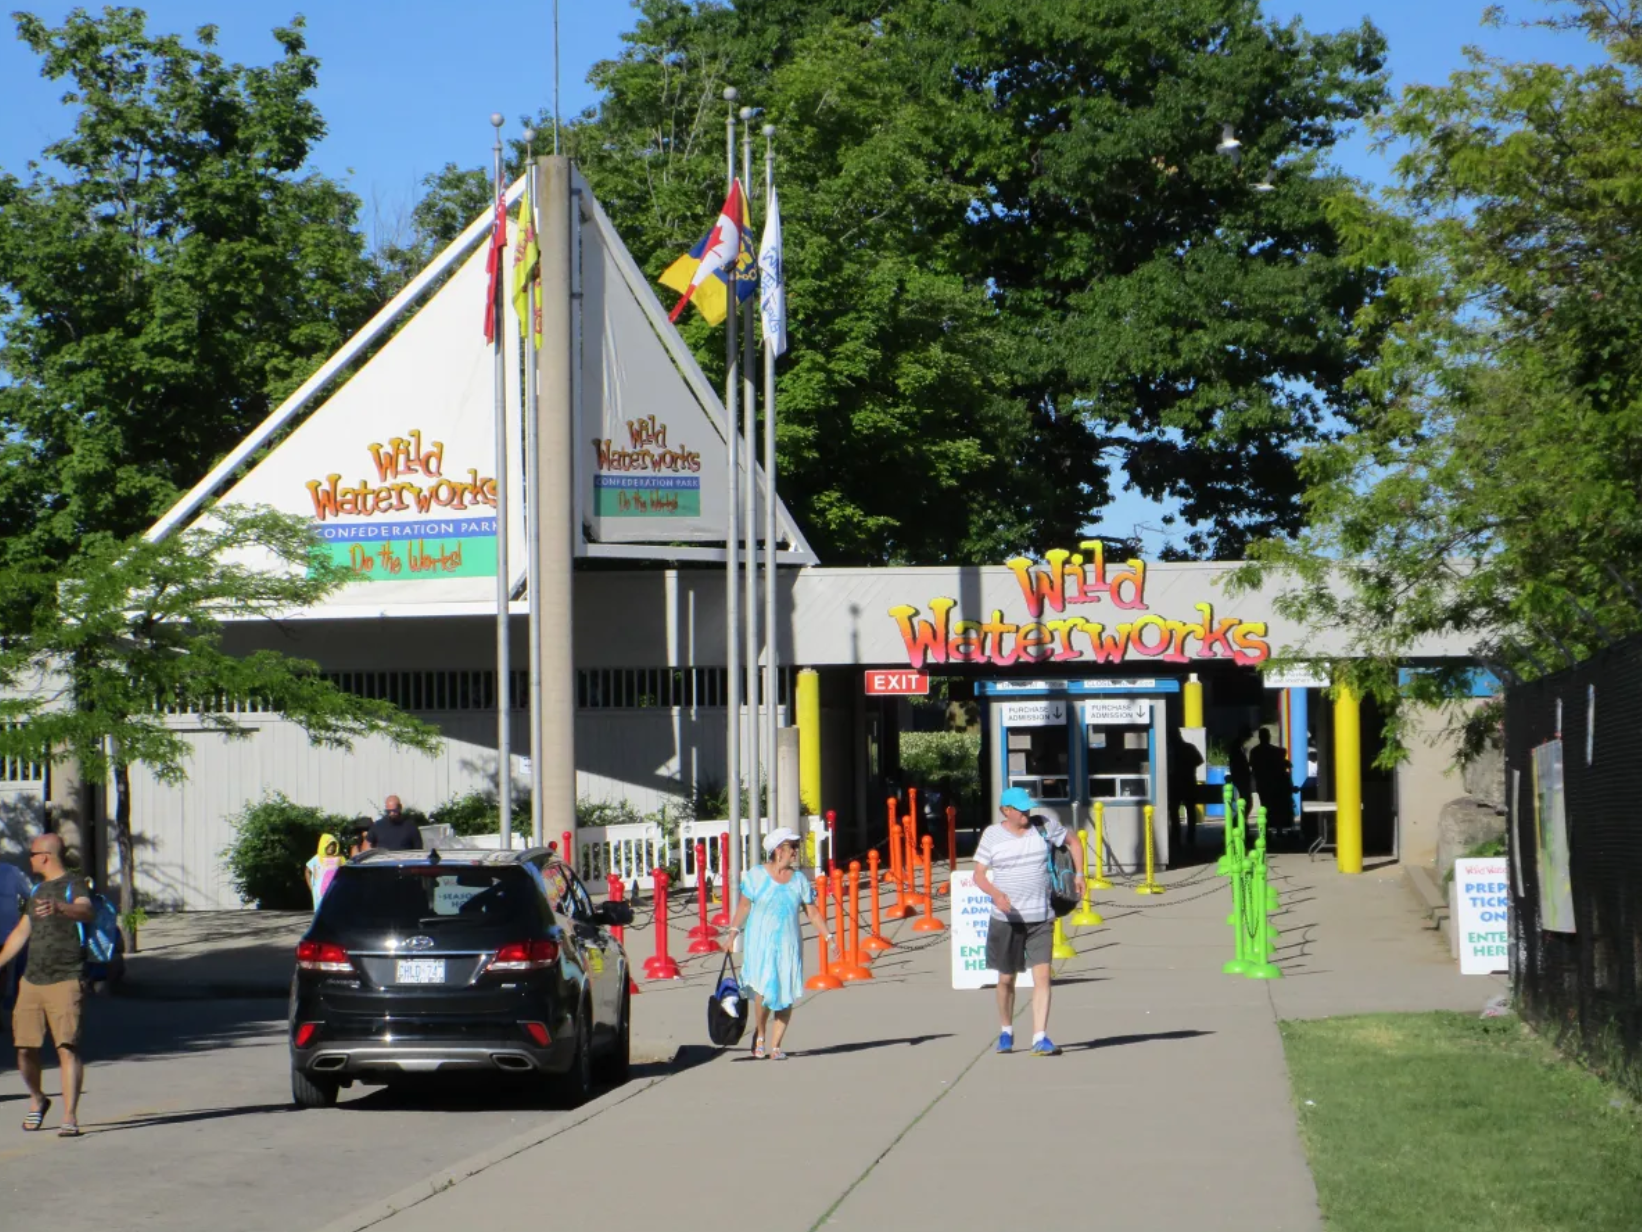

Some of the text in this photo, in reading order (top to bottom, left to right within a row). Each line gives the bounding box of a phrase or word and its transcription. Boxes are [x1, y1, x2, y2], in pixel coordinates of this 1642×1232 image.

[627, 413, 667, 450] Wild
[367, 429, 444, 482] Wild
[591, 437, 701, 473] Waterworks
[305, 467, 497, 521] Waterworks
[595, 477, 699, 488] CONFEDERATION PARK
[349, 542, 374, 576] Do
[377, 539, 402, 574] the
[1005, 540, 1149, 618] Wild
[888, 597, 1271, 669] Waterworks
[874, 674, 920, 690] EXIT
[1008, 705, 1049, 714] PURCHASE
[1008, 713, 1050, 722] ADMISSION
[1090, 711, 1134, 719] ADMISSION
[1091, 704, 1132, 712] PURCHASE
